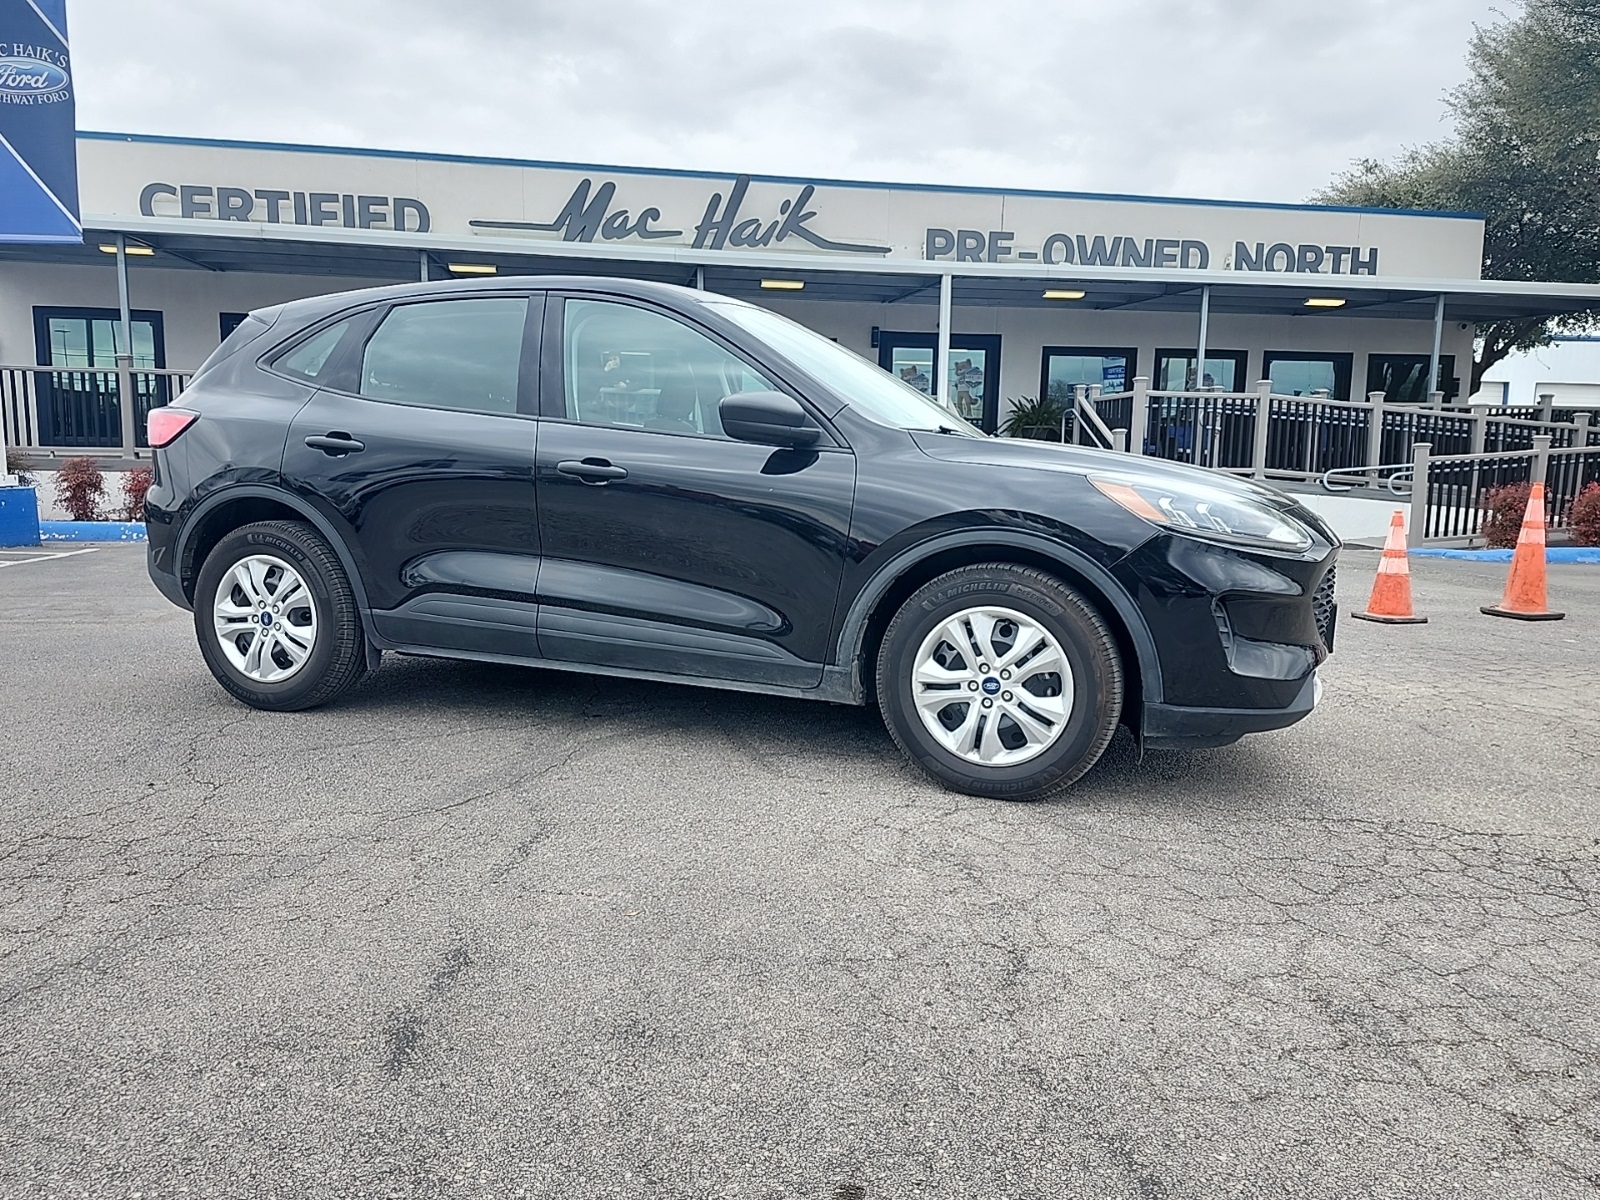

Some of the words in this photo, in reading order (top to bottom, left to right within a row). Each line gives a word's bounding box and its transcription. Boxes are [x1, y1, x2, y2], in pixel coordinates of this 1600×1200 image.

[13, 43, 68, 68] HAIK'S
[0, 63, 49, 88] Ford
[0, 92, 35, 105] HWAY
[37, 90, 69, 104] FORD
[139, 183, 432, 233] CERTIFIED
[469, 178, 682, 243] Mac
[692, 174, 892, 250] Haik
[925, 228, 1209, 270] PRE-OWNED
[1234, 241, 1379, 276] NORTH
[265, 536, 304, 560] MICHELIN
[947, 582, 1009, 598] MICHELIN
